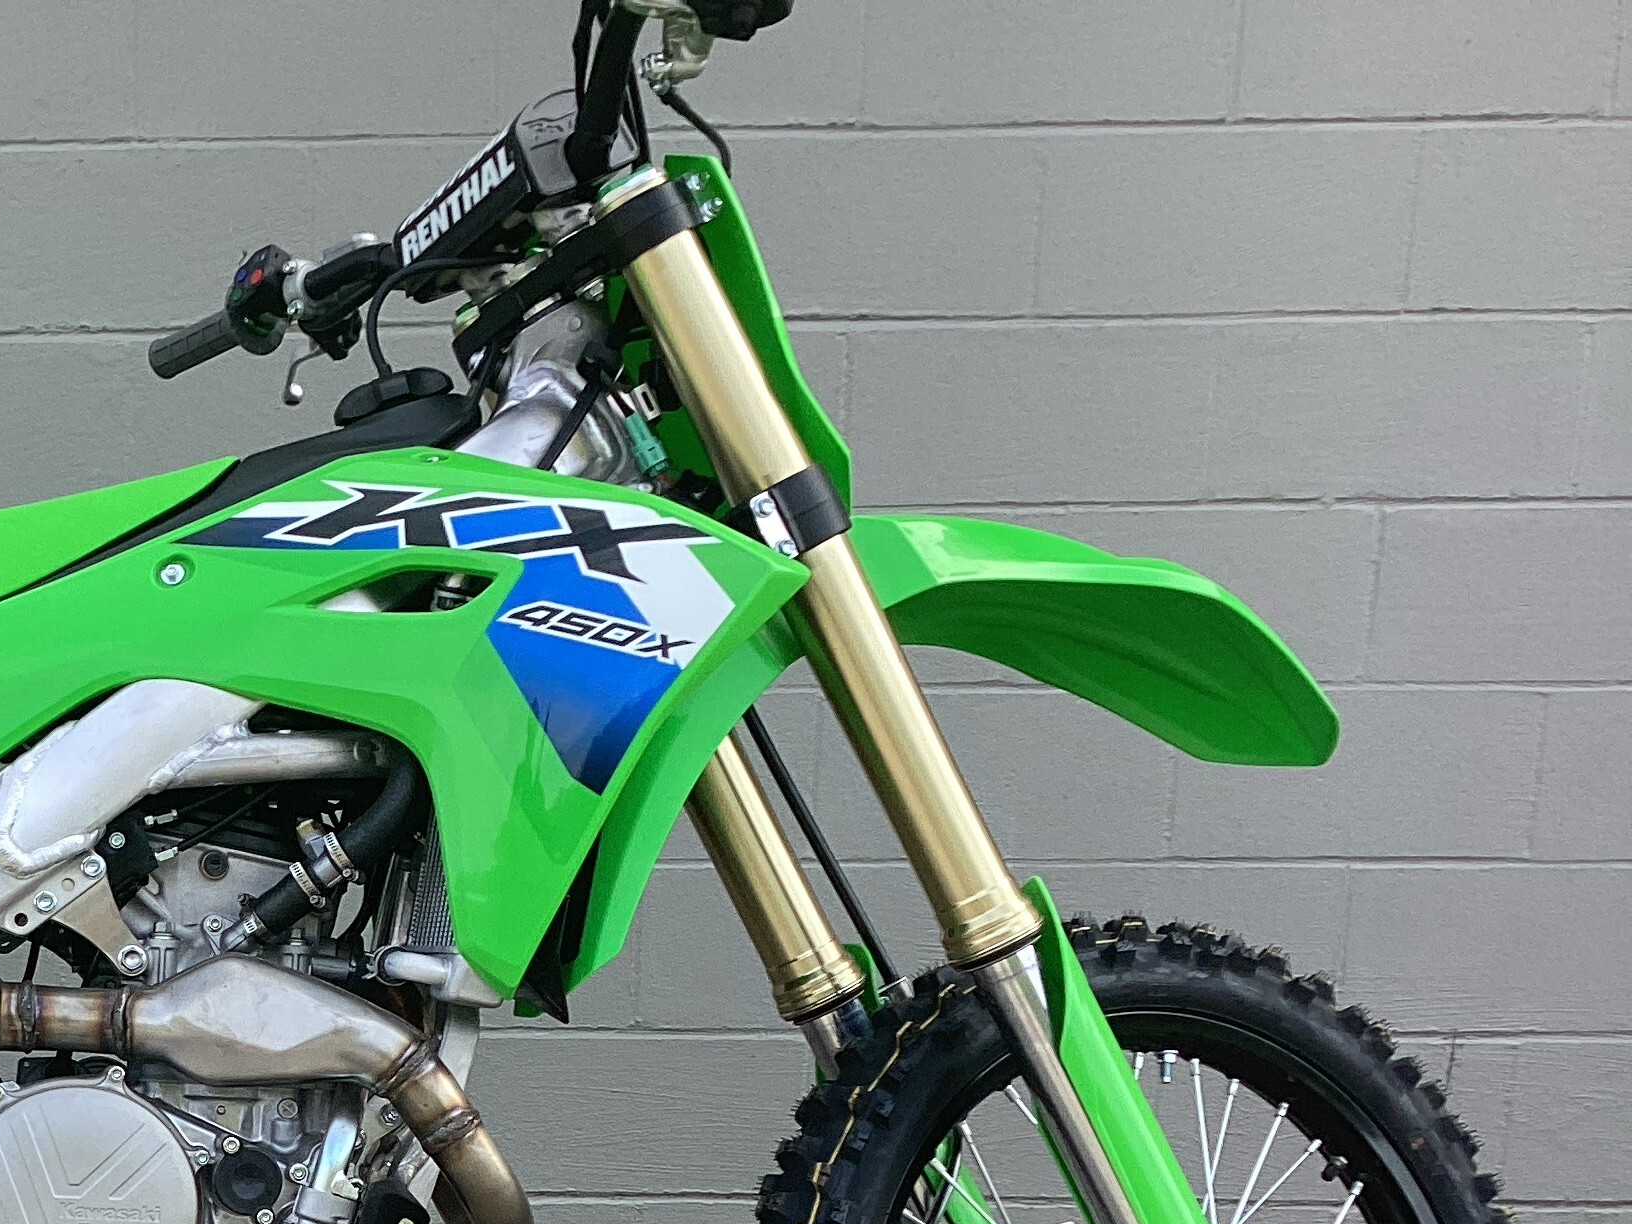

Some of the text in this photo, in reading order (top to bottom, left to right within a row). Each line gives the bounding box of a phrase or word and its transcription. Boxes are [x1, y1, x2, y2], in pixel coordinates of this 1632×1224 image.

[400, 145, 516, 268] RENTHAL
[281, 486, 717, 585] KX
[57, 1201, 161, 1224] Kawasaki
